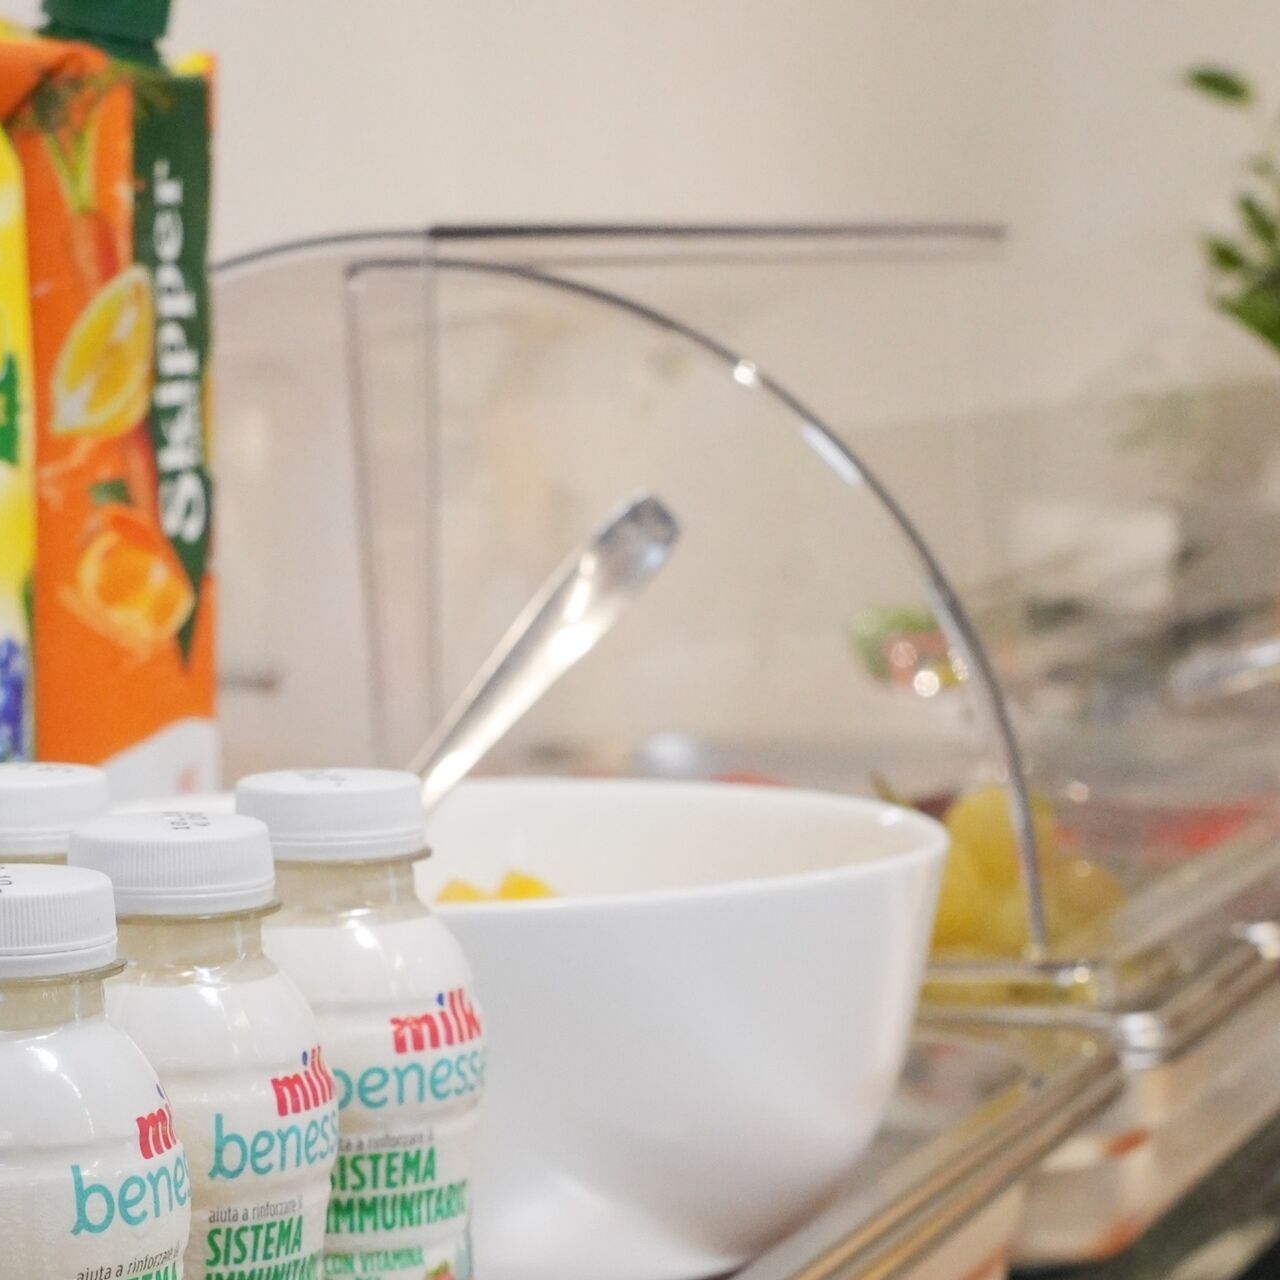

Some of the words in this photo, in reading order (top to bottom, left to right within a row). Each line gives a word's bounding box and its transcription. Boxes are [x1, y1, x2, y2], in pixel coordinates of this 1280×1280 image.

[390, 988, 481, 1055] milk
[332, 1049, 486, 1109] eness
[330, 1146, 436, 1192] ISTEMA
[209, 1207, 238, 1224] aiuta
[242, 1207, 249, 1221] a
[252, 1199, 297, 1220] rinforzare
[116, 1264, 123, 1278] a
[127, 1247, 173, 1275] rinforzare
[205, 1215, 304, 1267] SISTEMA
